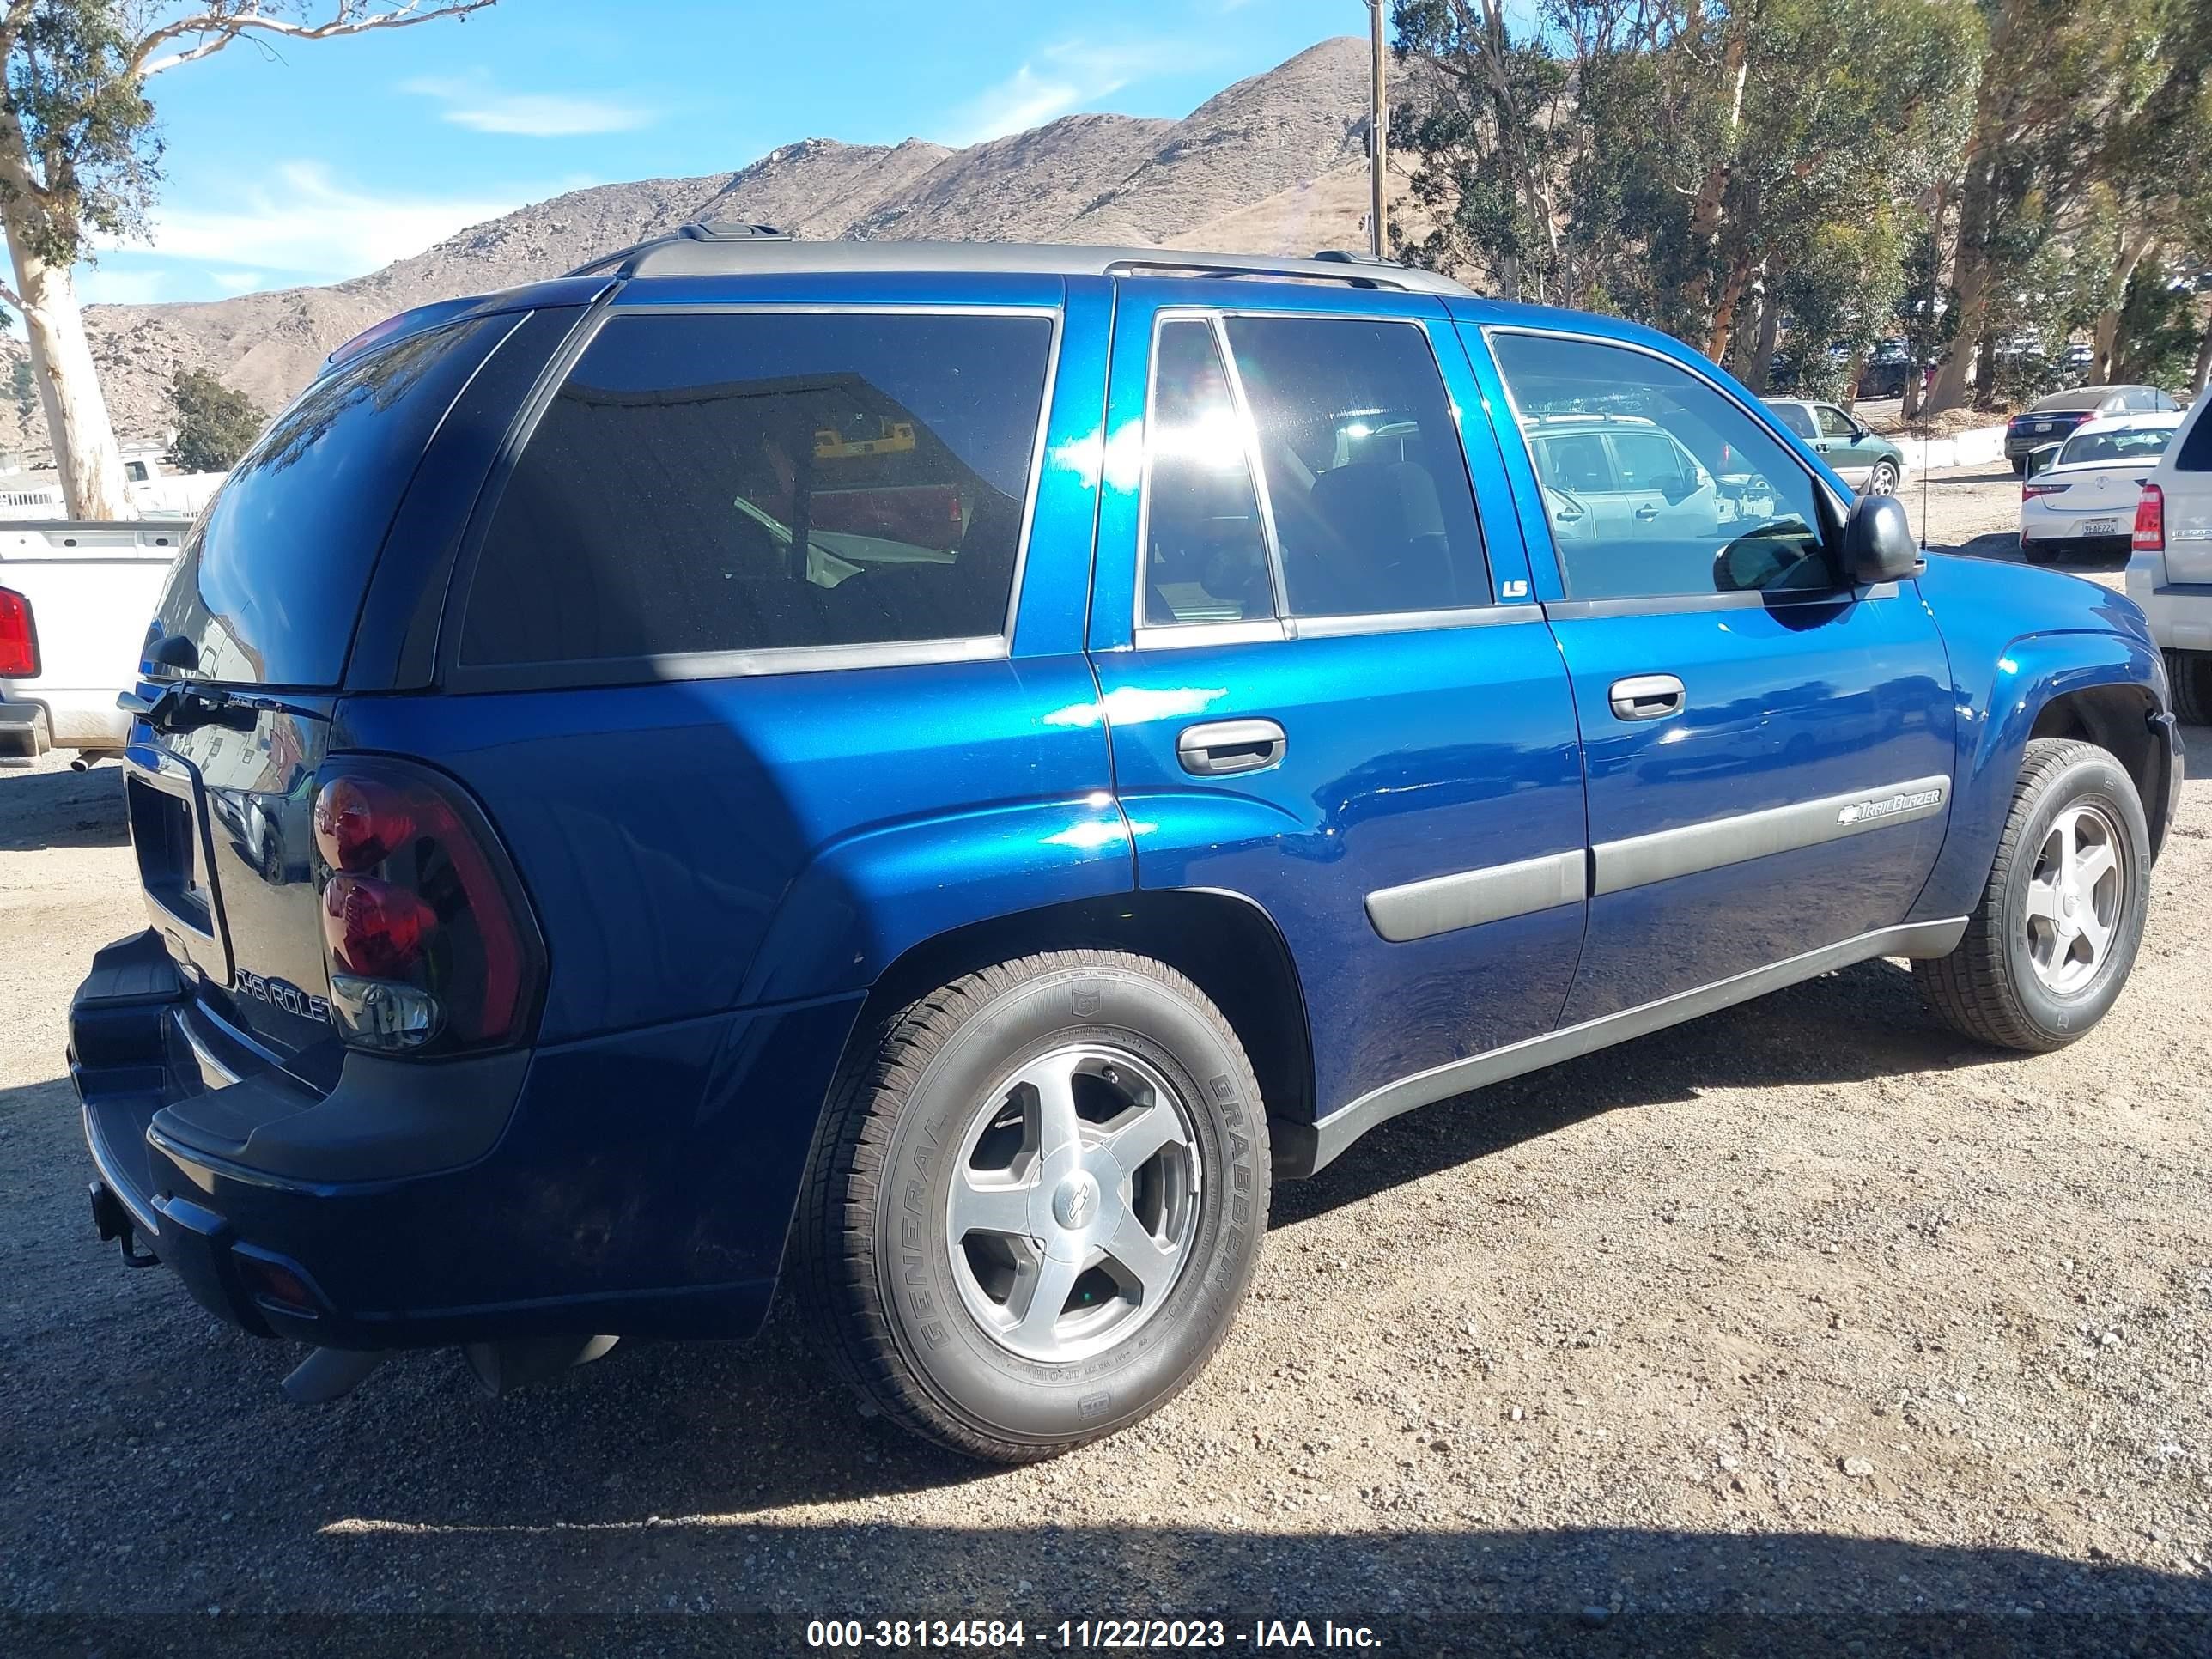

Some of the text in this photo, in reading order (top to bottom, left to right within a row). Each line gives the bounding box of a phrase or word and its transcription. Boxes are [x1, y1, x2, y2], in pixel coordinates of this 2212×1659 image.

[1502, 580, 1528, 598] LS
[234, 967, 334, 1024] CHEVROLET
[902, 1115, 951, 1351] GENERAL
[1209, 1073, 1251, 1291] GRABBER
